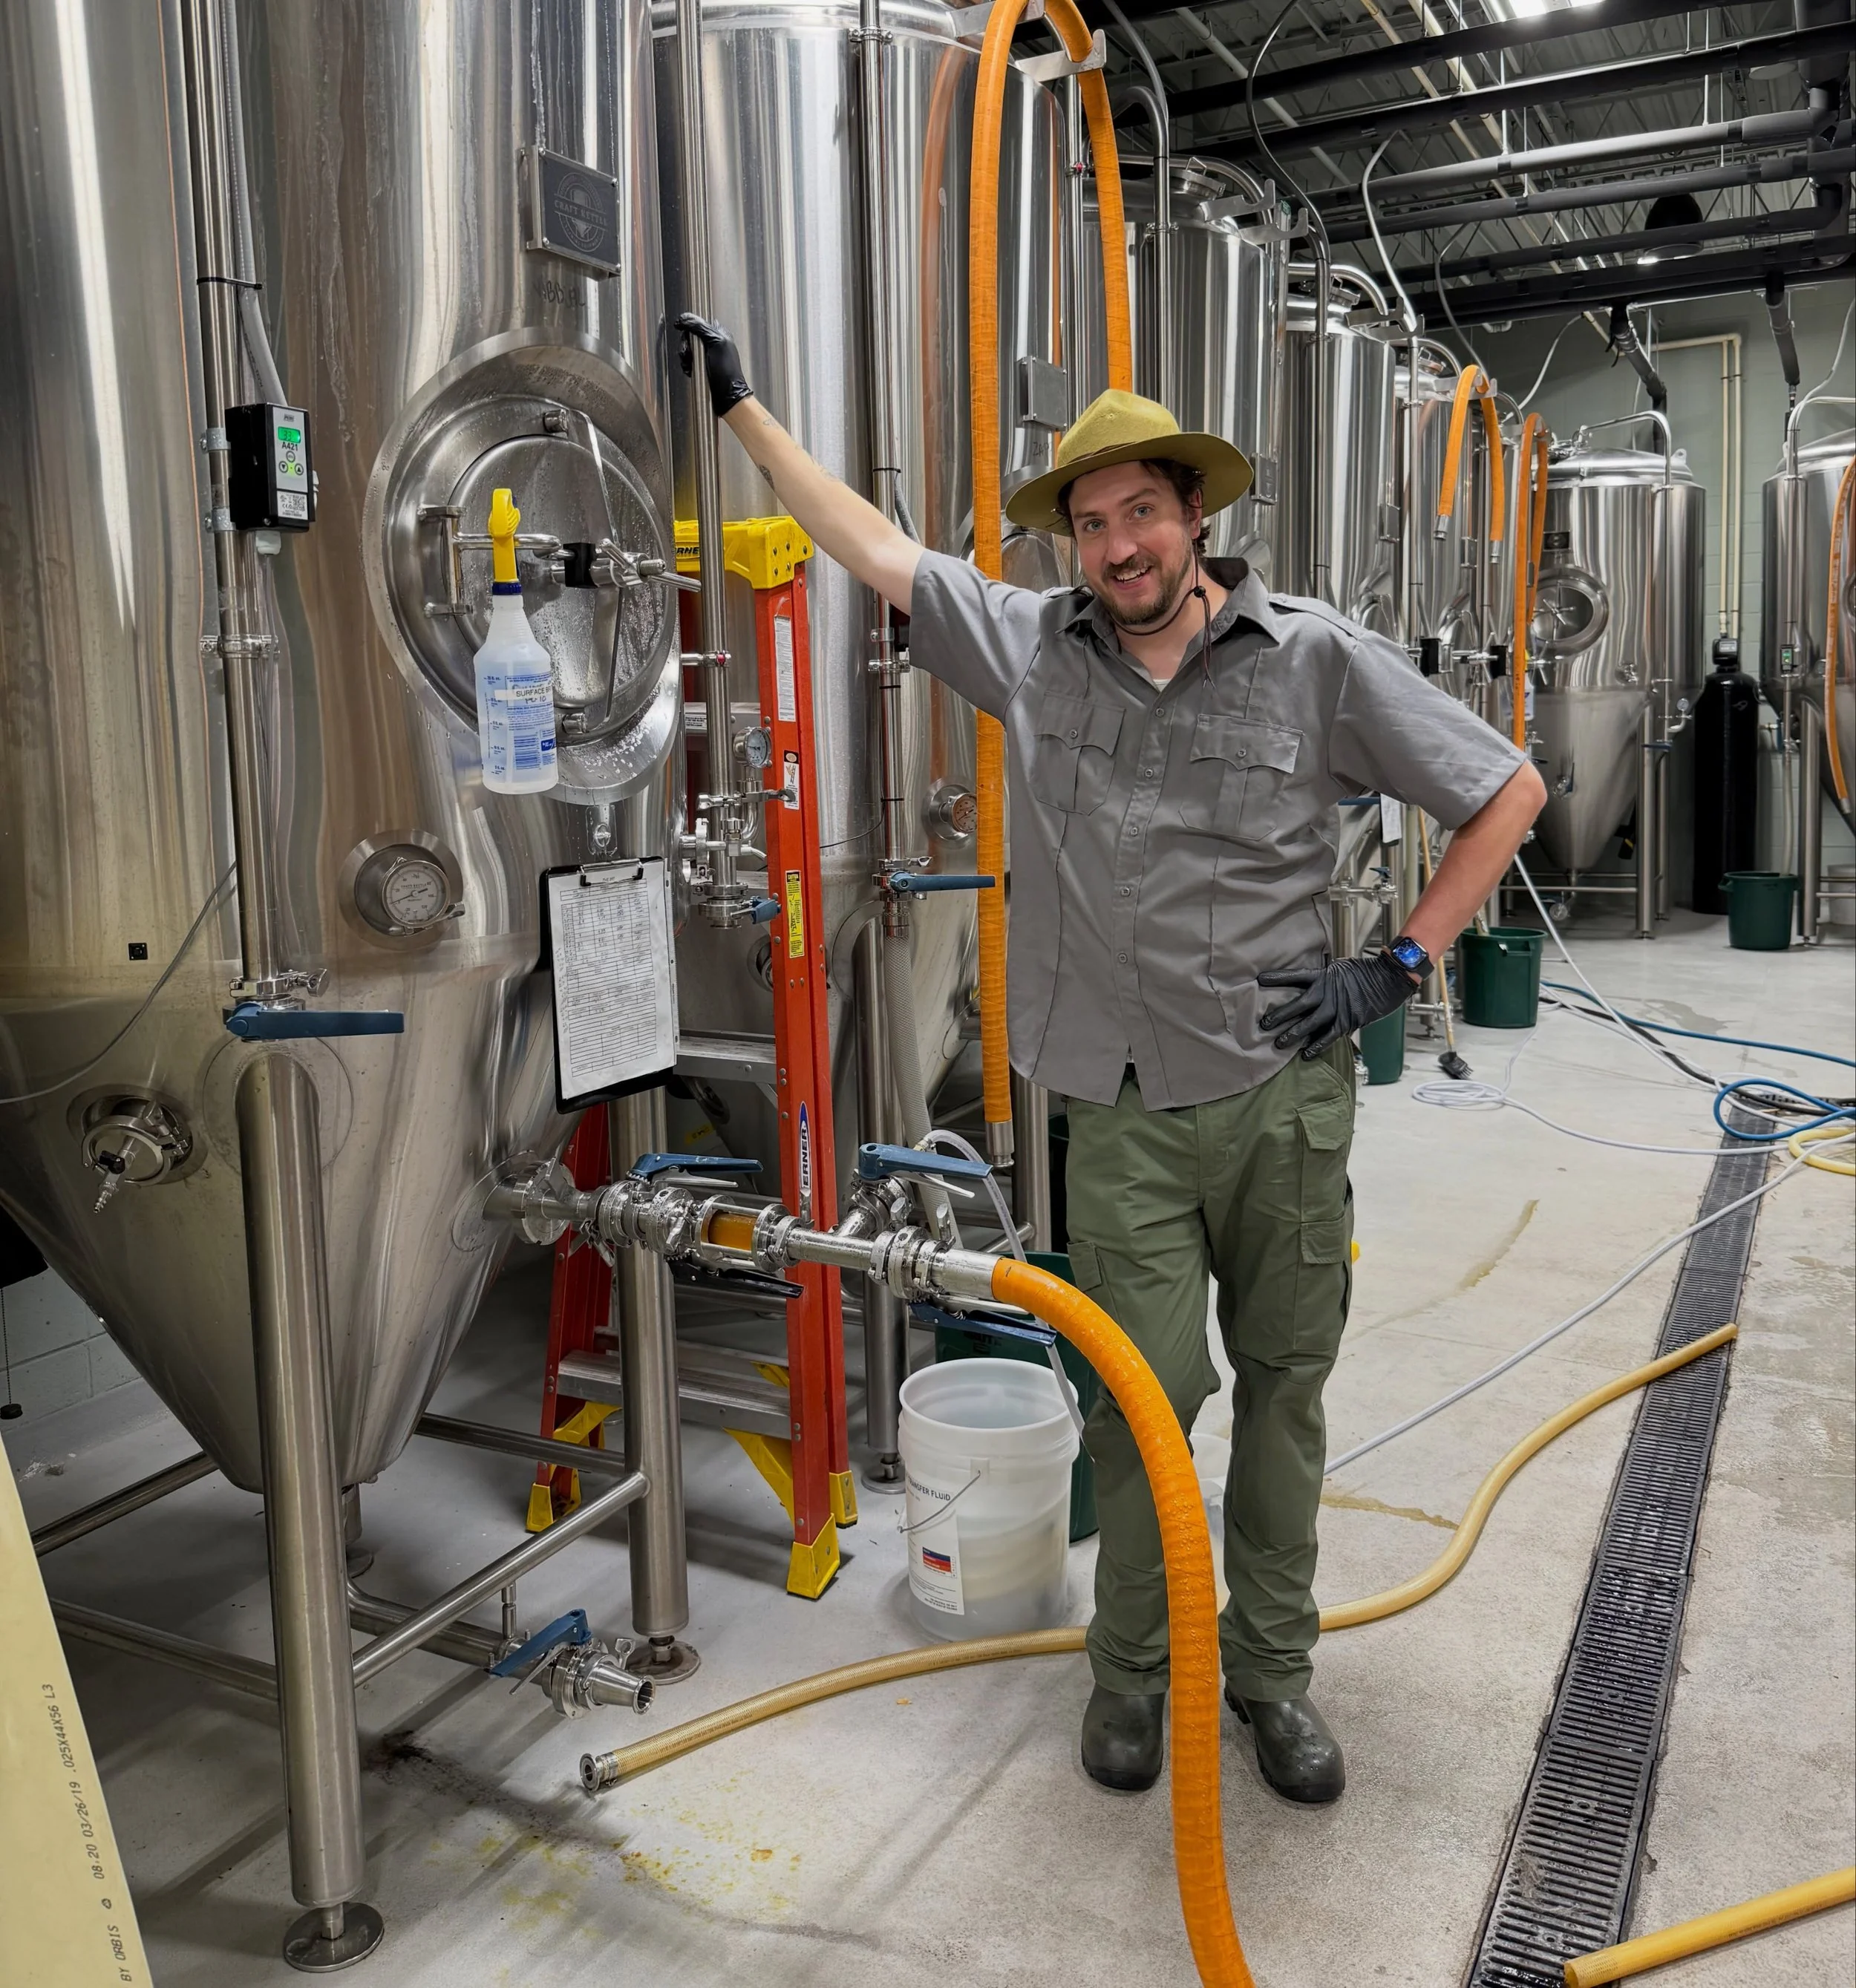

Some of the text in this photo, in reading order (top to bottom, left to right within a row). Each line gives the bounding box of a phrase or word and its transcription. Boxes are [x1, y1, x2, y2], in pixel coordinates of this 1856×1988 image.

[554, 200, 578, 215] CRAFT
[281, 441, 298, 451] A421
[676, 546, 699, 555] RNE
[516, 687, 545, 697] SURFACE
[931, 1490, 951, 1501] FLUID
[42, 1684, 55, 1700] L3
[48, 1706, 76, 1774] .025X44X56
[69, 1782, 94, 1837] 03/26/19
[107, 1924, 126, 1961] ORBIS
[118, 1967, 132, 1983] BY
